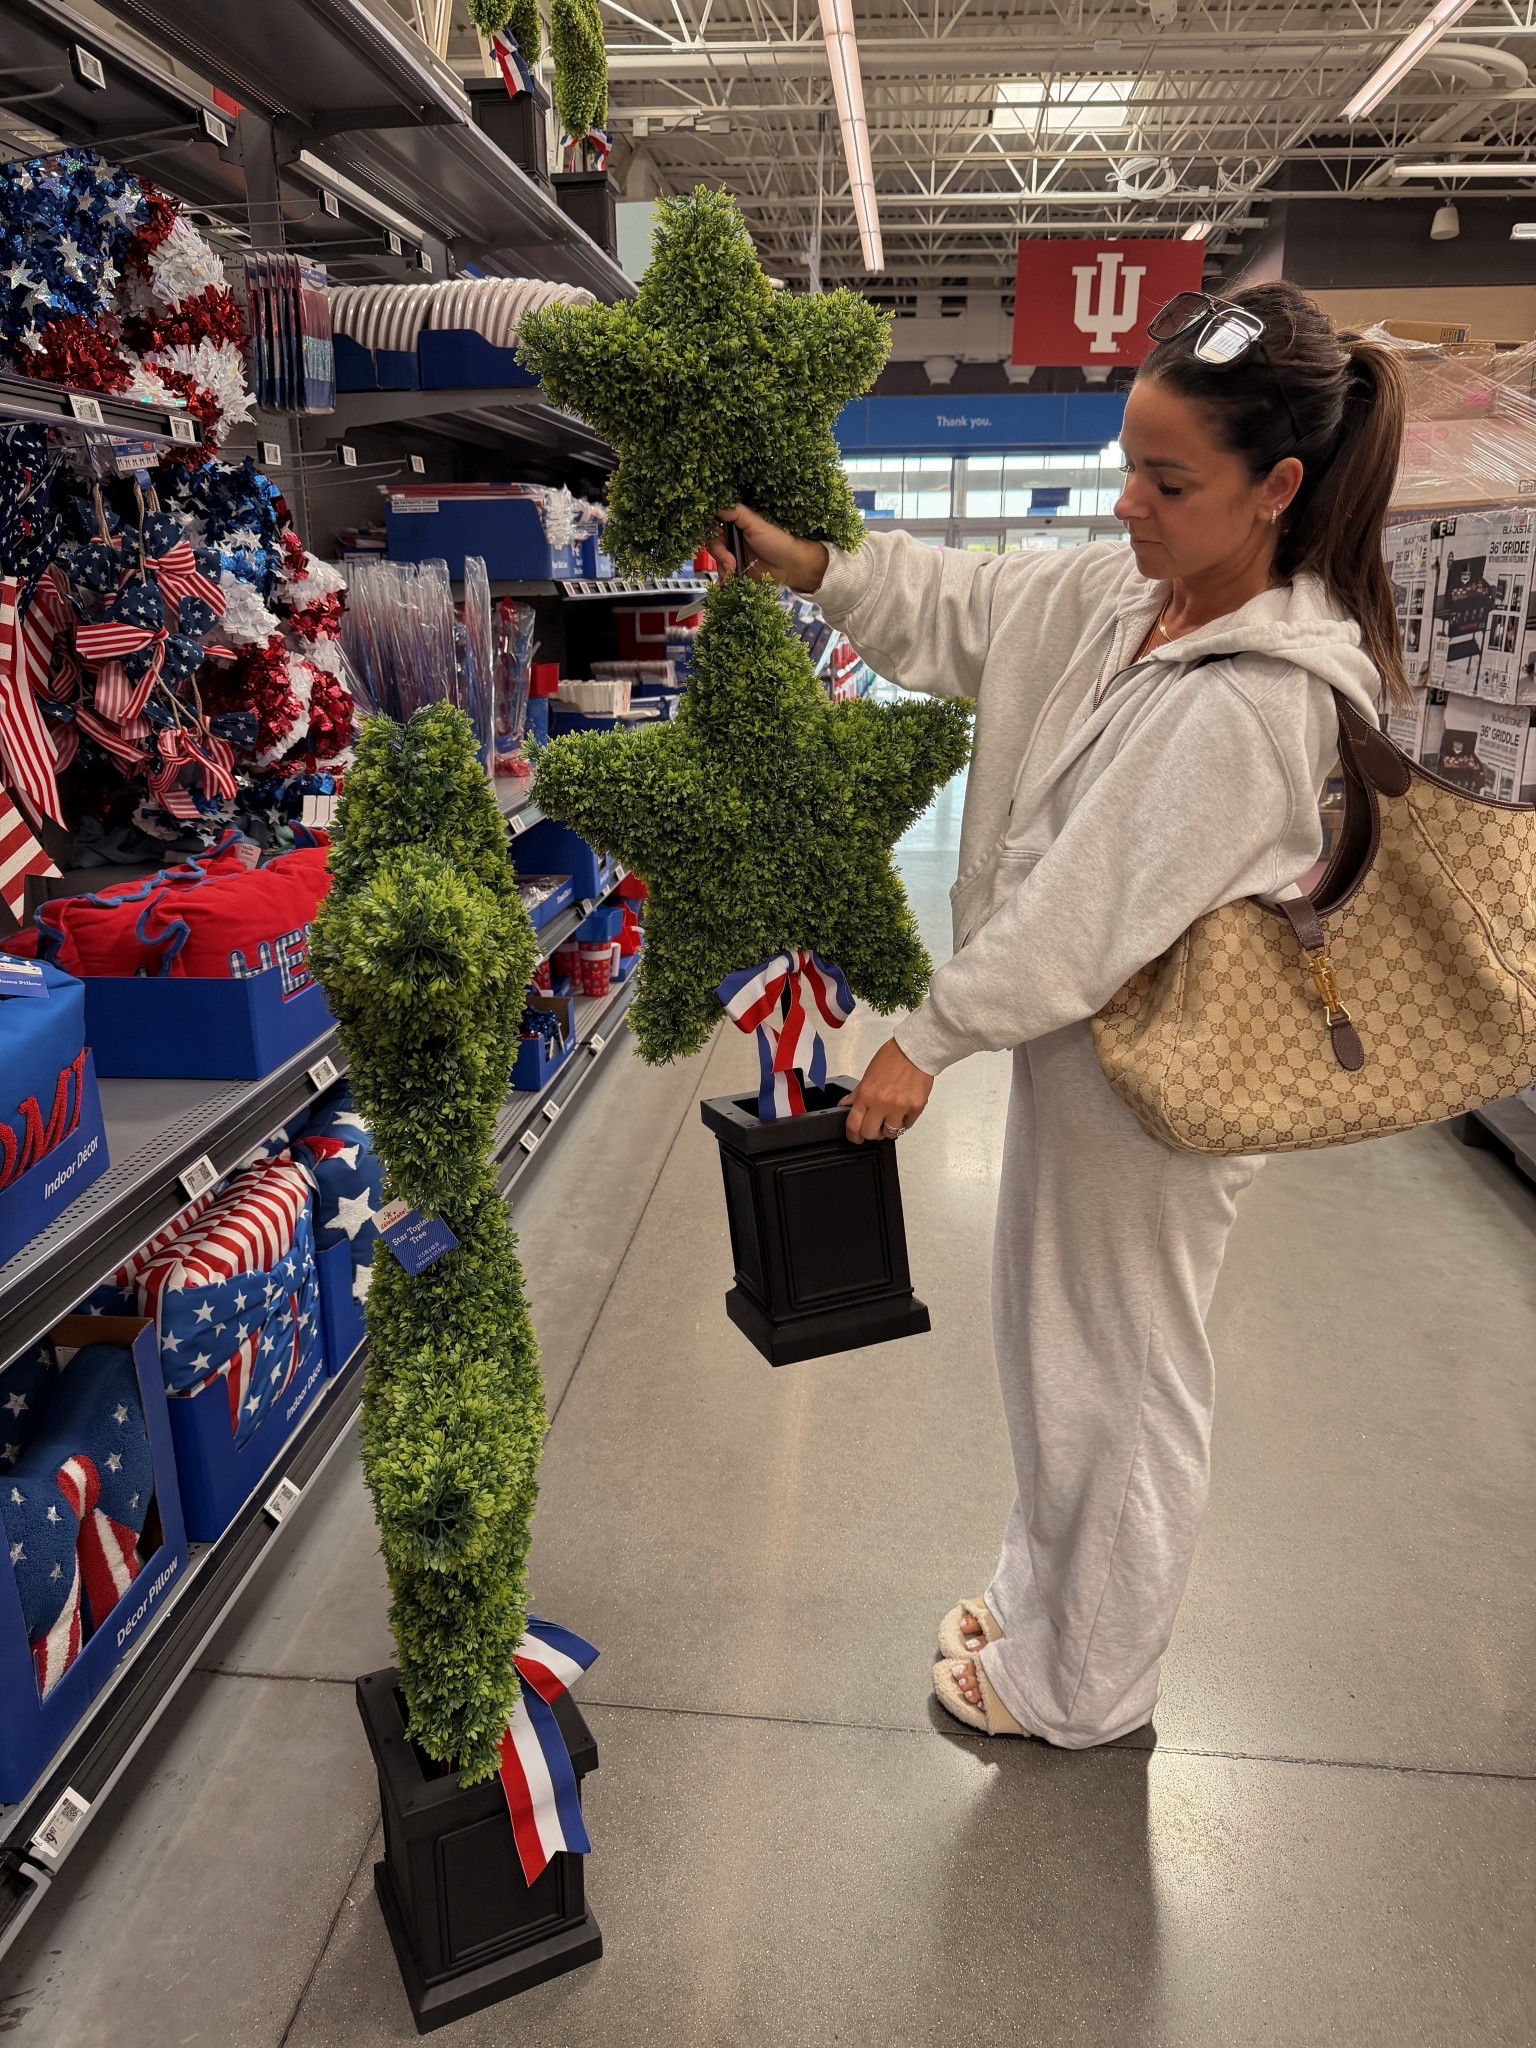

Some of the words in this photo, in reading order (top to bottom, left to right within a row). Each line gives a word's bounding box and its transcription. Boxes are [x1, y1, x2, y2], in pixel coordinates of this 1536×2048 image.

[936, 415, 967, 427] Thank
[970, 417, 991, 430] you.
[1492, 728, 1520, 747] GRIDDLE
[44, 1158, 76, 1200] Indoor
[77, 1134, 98, 1170] Décor
[392, 1232, 408, 1246] Star
[406, 1217, 434, 1234] Topiar
[410, 1231, 428, 1244] Tree
[286, 1384, 308, 1422] Indoor
[308, 1358, 323, 1390] Décor
[116, 1598, 148, 1648] Décor
[148, 1556, 178, 1604] Pillow
